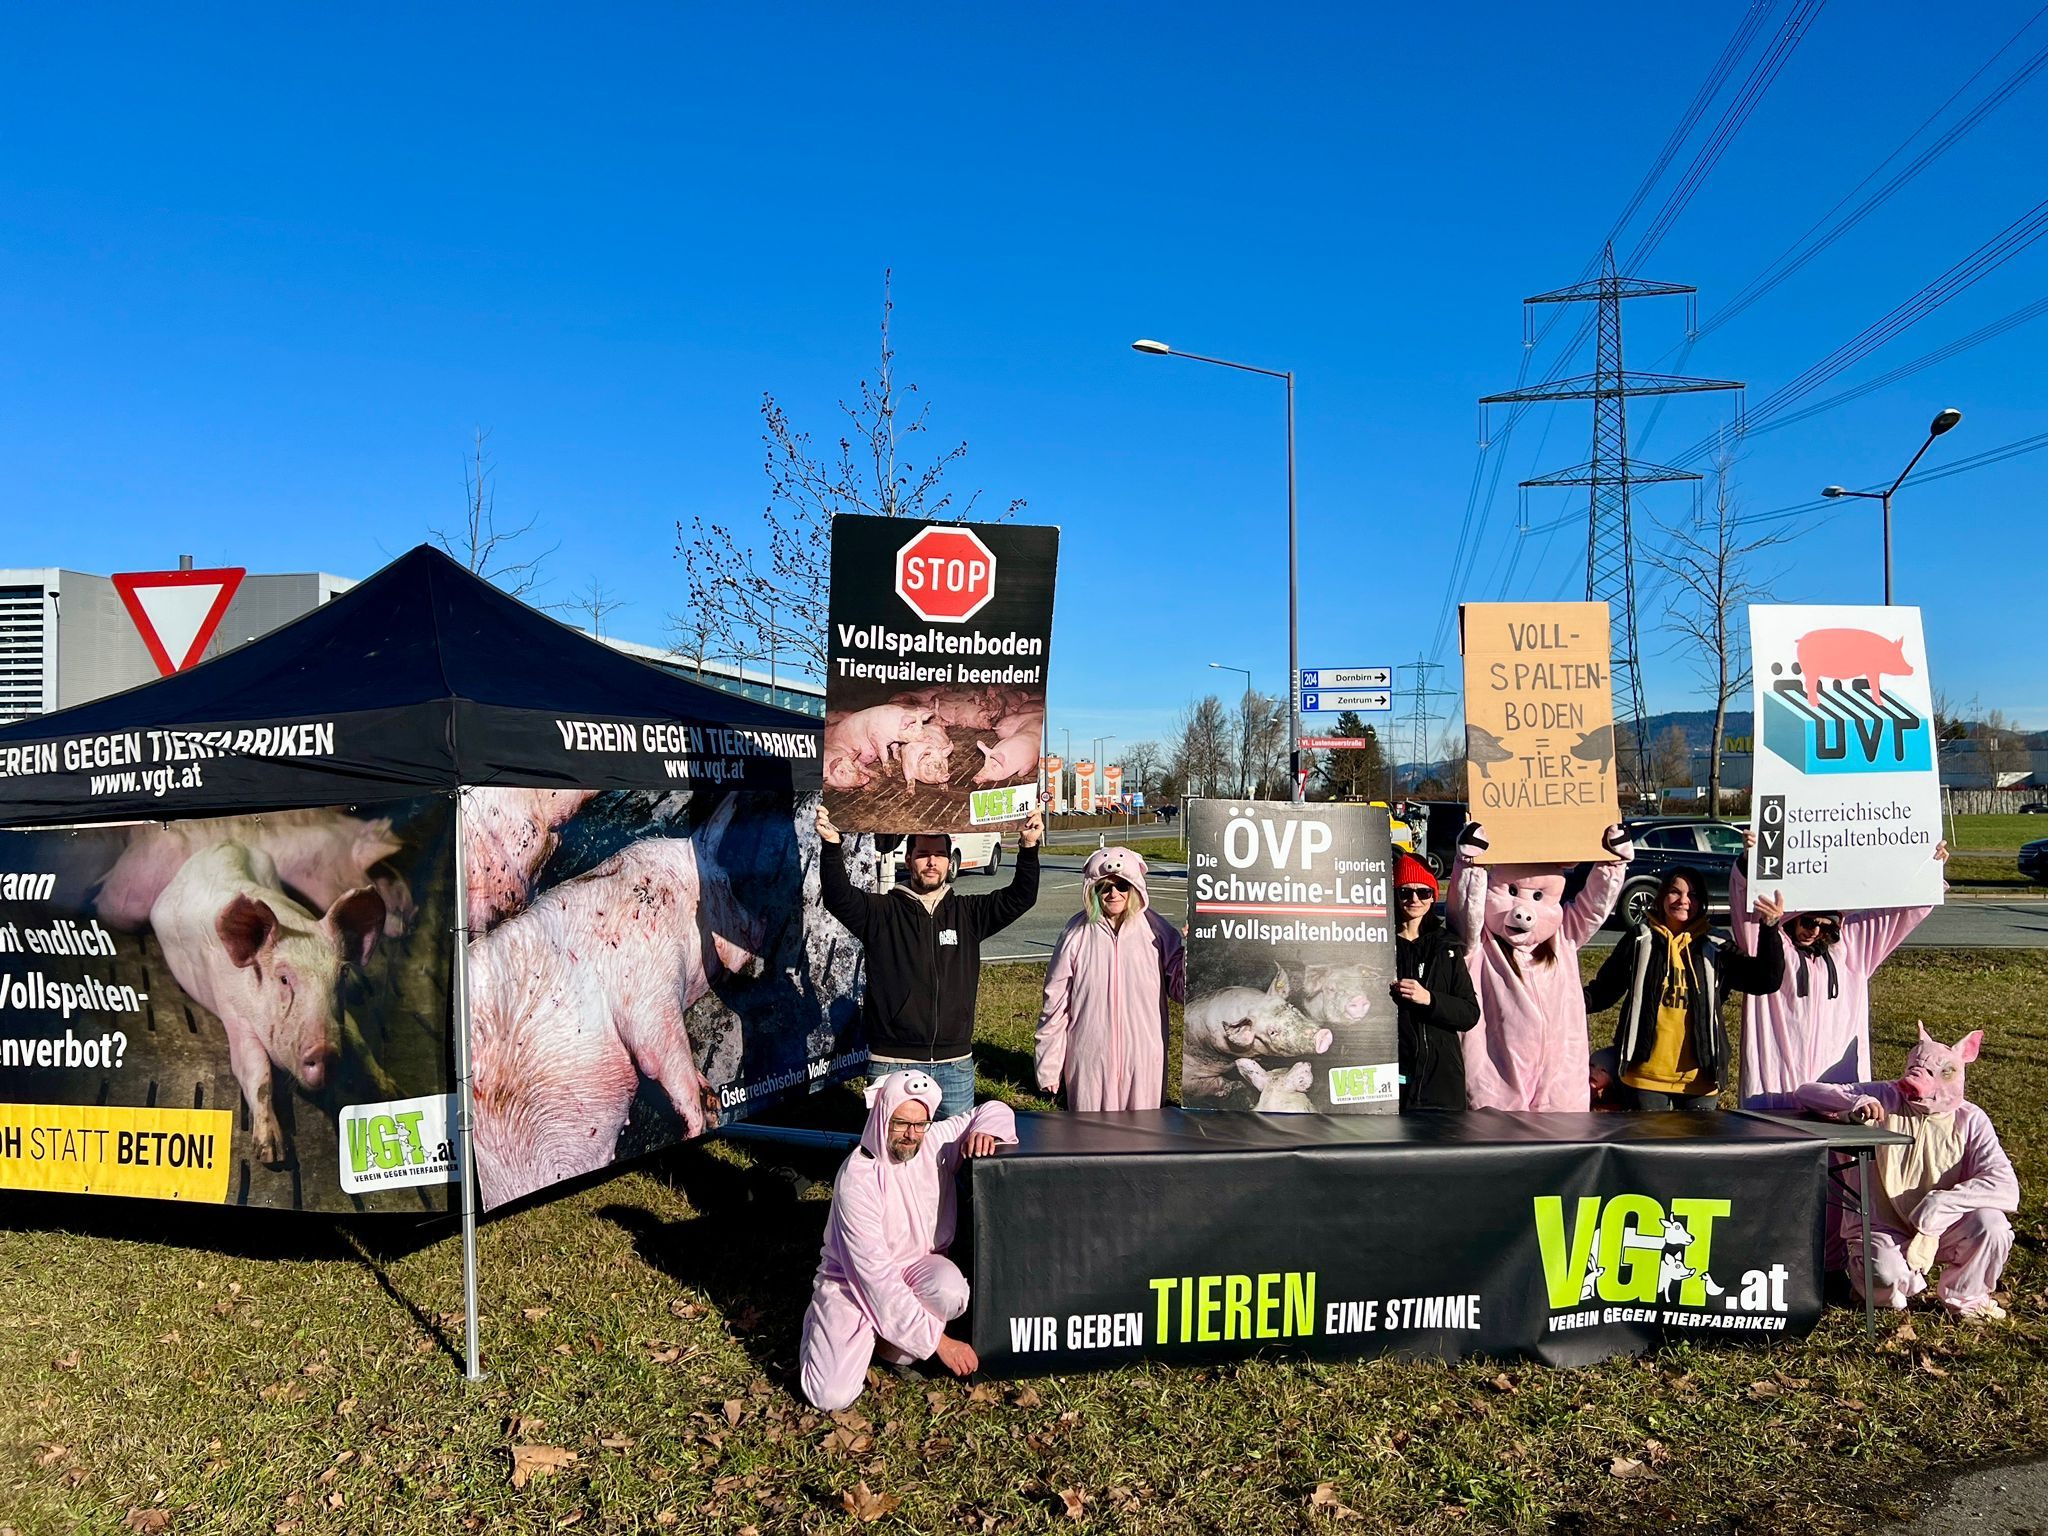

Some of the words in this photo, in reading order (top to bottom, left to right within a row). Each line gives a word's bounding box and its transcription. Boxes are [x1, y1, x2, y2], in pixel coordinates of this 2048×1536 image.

[906, 556, 986, 593] STOP
[838, 624, 1042, 656] Vollspaltenboden
[1508, 623, 1580, 651] VOLL-
[837, 657, 952, 684] Tierquälerei
[957, 664, 1040, 684] beenden!
[1304, 673, 1317, 686] 204
[1335, 674, 1372, 682] Dornbirn
[1490, 663, 1608, 691] SPALTEN-
[1306, 695, 1316, 709] P
[1505, 702, 1584, 731] BODEN
[64, 732, 141, 770] GEGEN
[147, 722, 334, 763] TIERFABRIKEN
[555, 720, 637, 753] VEREIN
[642, 724, 703, 754] GEGEN
[706, 728, 817, 759] TIERFABRIKEN
[90, 762, 203, 797] www.vgt.at
[664, 758, 745, 784] www.vgt.at
[972, 788, 1029, 818] VGT.at
[1196, 853, 1218, 868] Die
[1224, 806, 1332, 870] ÖVP
[1335, 857, 1385, 875] ignoriert
[0, 872, 56, 900] ann
[1196, 874, 1387, 905] Schweine-Leid
[24, 919, 117, 956] endlich
[1195, 925, 1217, 940] auf
[1221, 920, 1388, 945] Vollspaltenboden
[0, 1029, 128, 1068] nverbot?
[721, 1068, 806, 1108] Österreichischer
[1332, 1068, 1392, 1097] VGT.at
[0, 1126, 21, 1158] H
[30, 1127, 109, 1163] STATT
[118, 1131, 214, 1169] BETON!
[346, 1111, 457, 1173] VGT.at
[354, 1173, 381, 1183] VEREIN
[384, 1169, 408, 1179] GEGEN
[410, 1164, 458, 1176] TIERFABRIKEN
[1533, 1193, 1789, 1312] VGT.at
[1010, 1316, 1058, 1353] WIR
[1067, 1312, 1143, 1351] GEBEN
[1149, 1272, 1317, 1345] TIEREN
[1325, 1301, 1378, 1335] EINE
[1384, 1294, 1481, 1330] STIMME
[1548, 1310, 1599, 1332] VEREIN
[1603, 1307, 1657, 1324] GEGEN
[1662, 1310, 1786, 1330] TIERFABRIKEN
